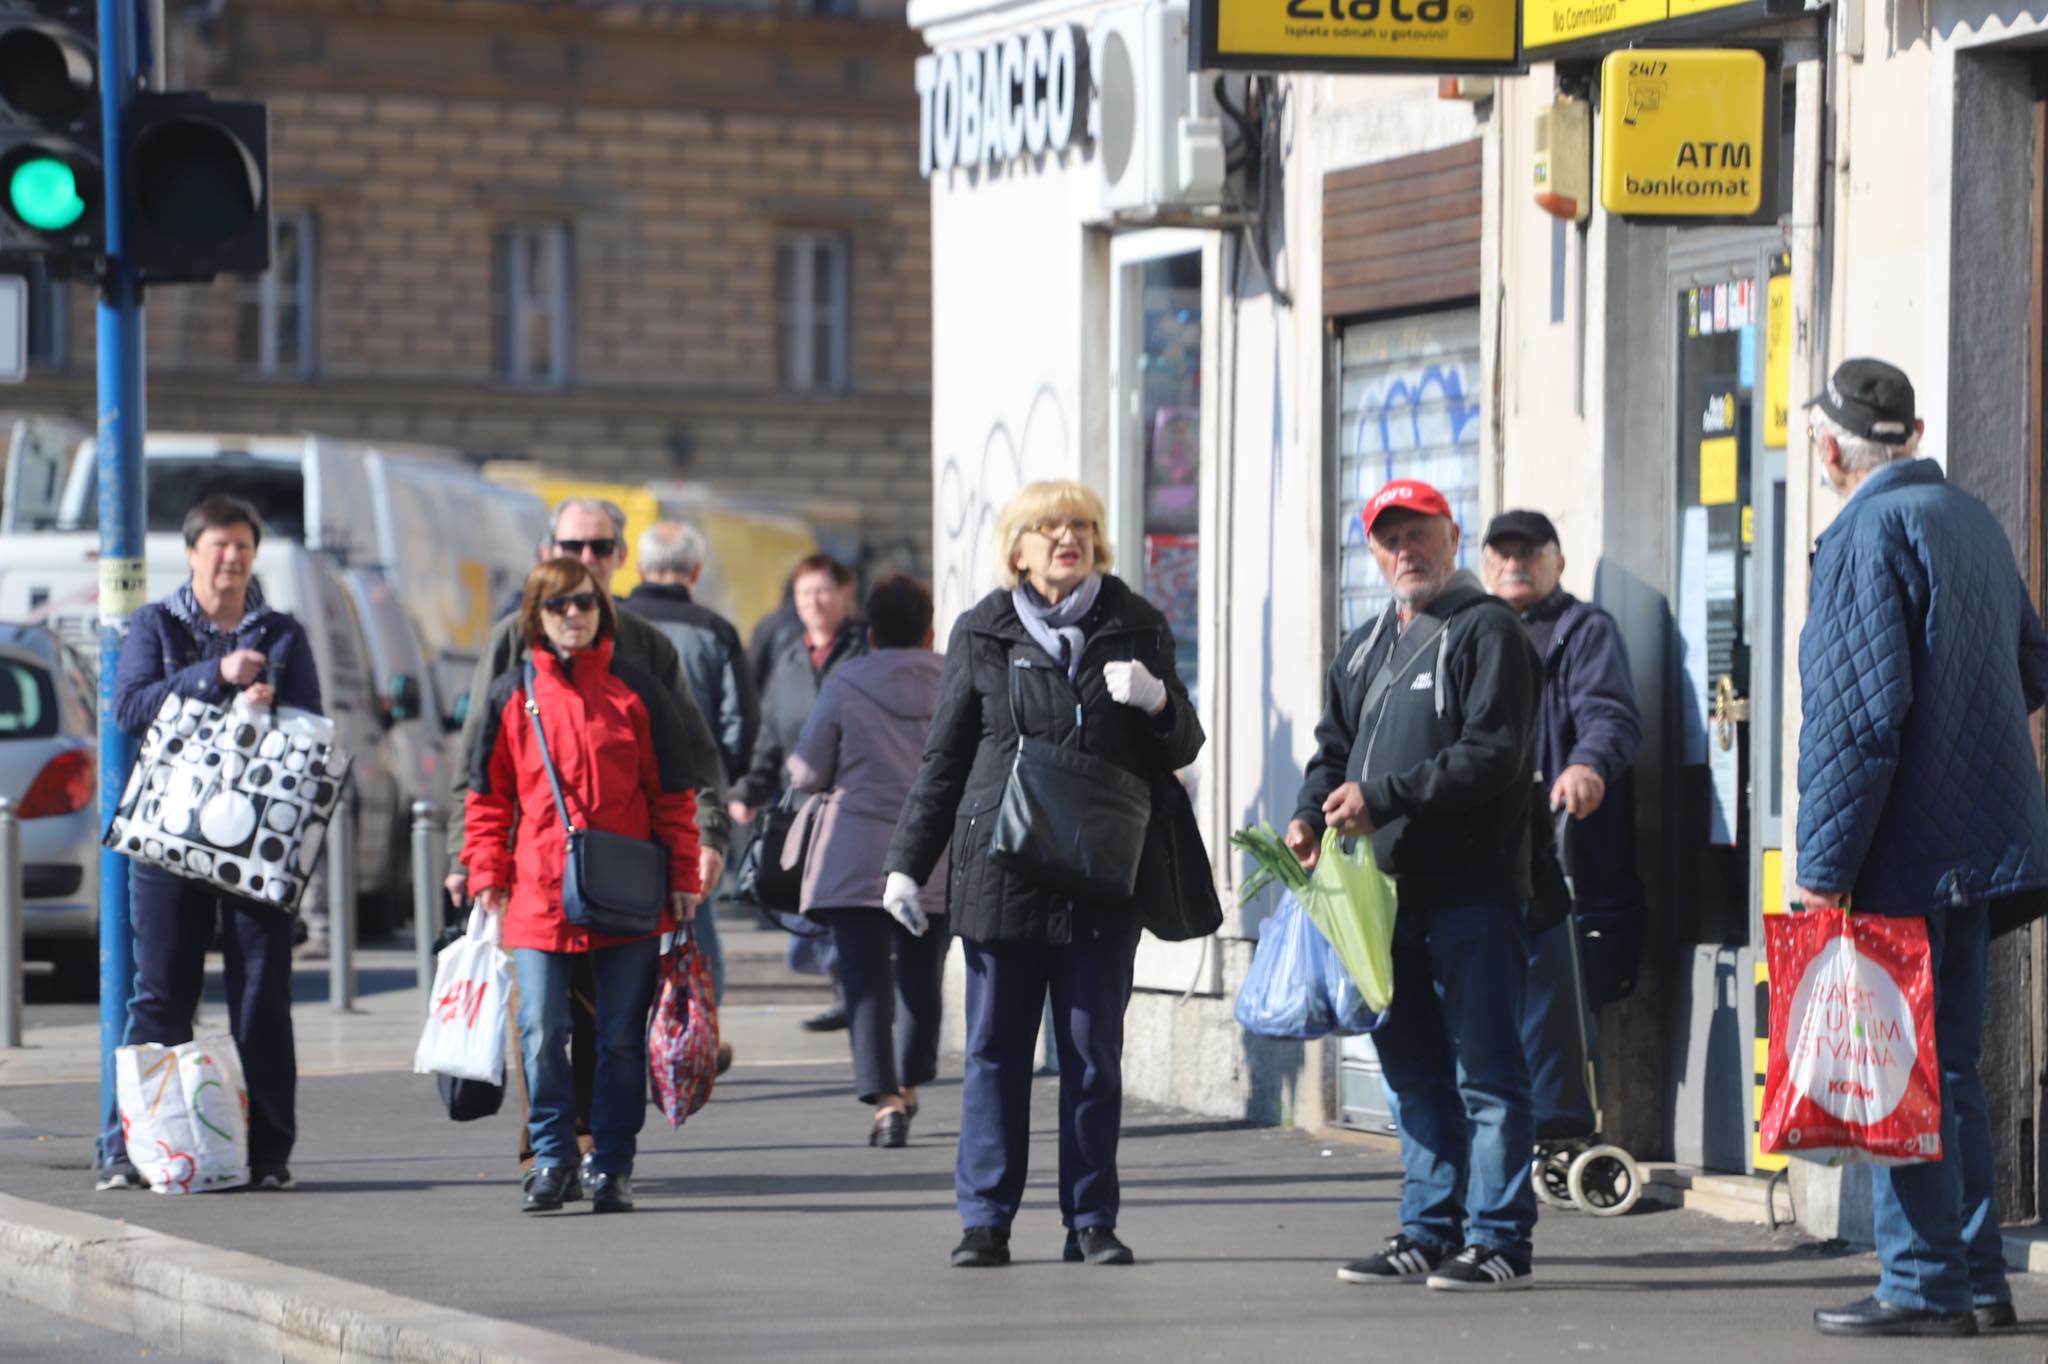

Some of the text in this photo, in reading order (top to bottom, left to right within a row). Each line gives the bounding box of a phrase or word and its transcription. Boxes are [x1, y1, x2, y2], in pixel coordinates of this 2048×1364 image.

[1553, 2, 1616, 32] No Commission
[1333, 25, 1376, 38] odmah
[1380, 29, 1389, 39] u
[1629, 60, 1667, 77] 24/7
[915, 22, 1077, 179] TOBACCO
[1677, 142, 1751, 169] ATM
[1626, 174, 1750, 197] bankomat
[1826, 1008, 1843, 1032] U
